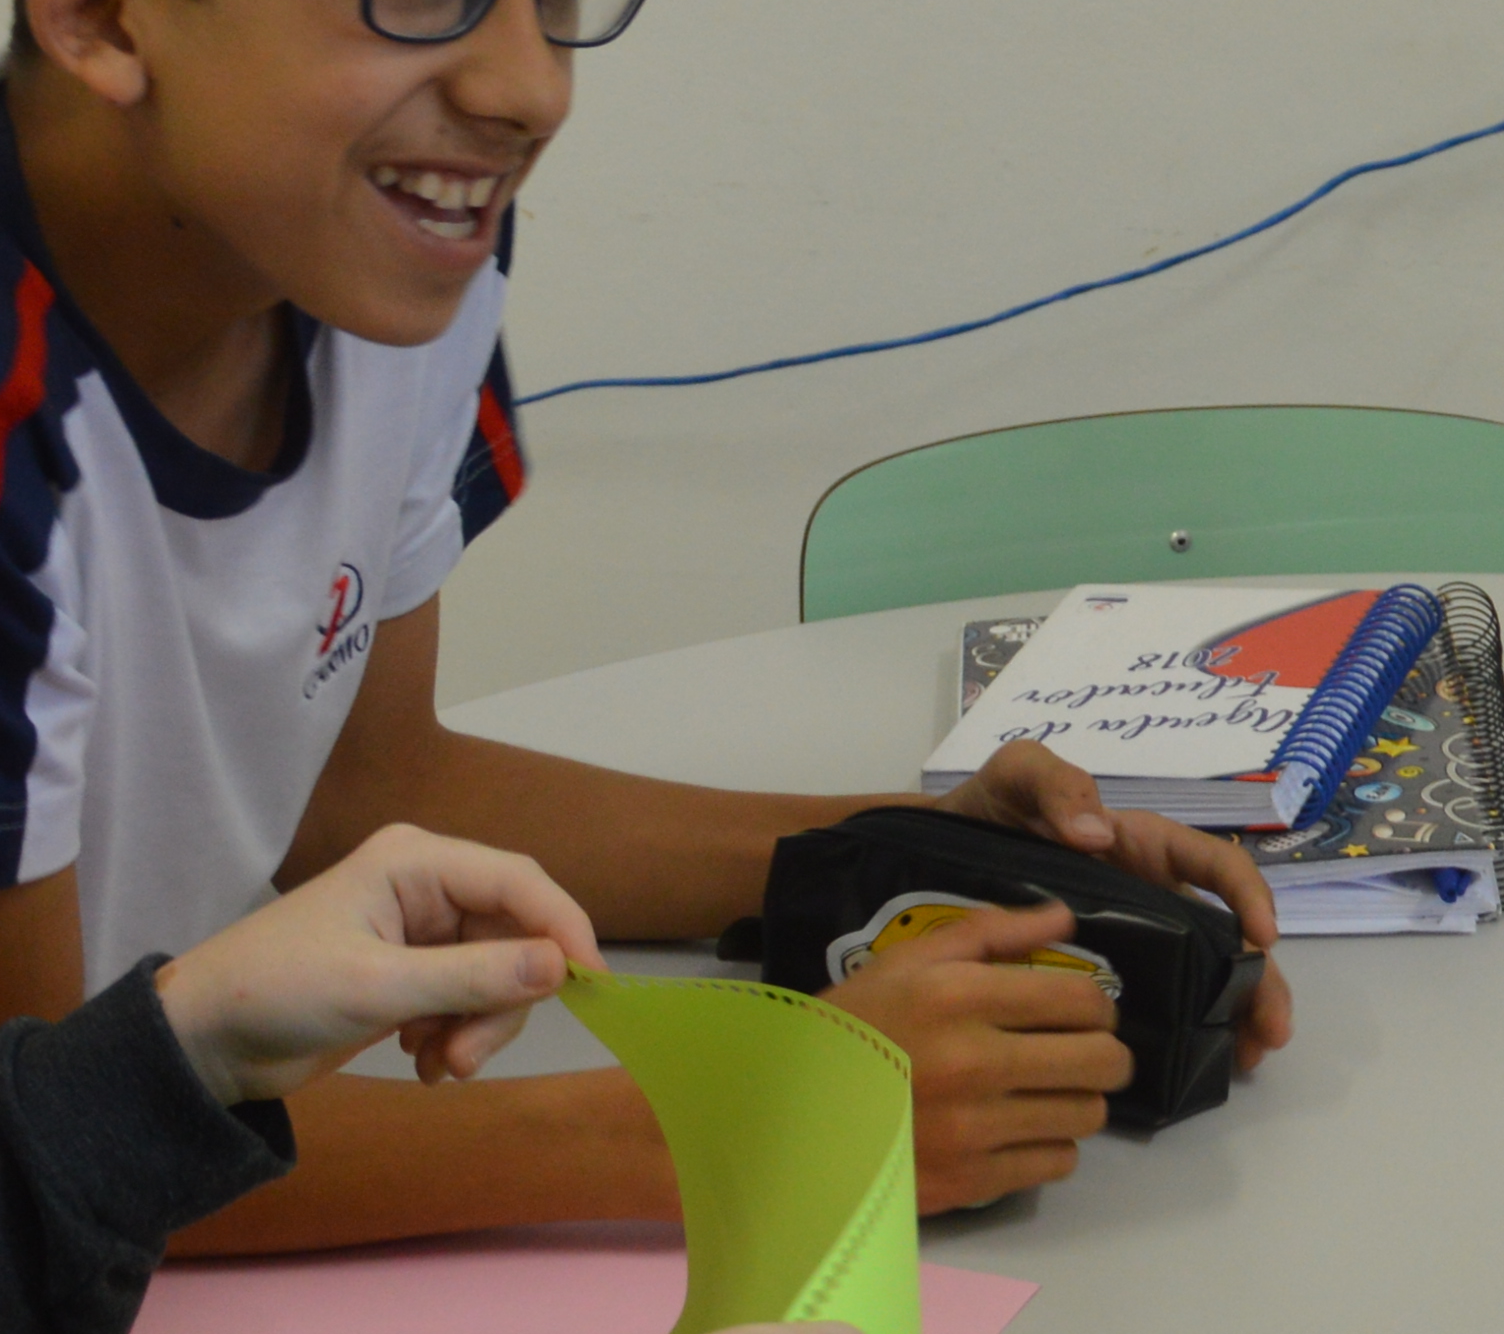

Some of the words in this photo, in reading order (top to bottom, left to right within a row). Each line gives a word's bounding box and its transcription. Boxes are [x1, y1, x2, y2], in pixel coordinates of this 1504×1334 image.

[1128, 645, 1243, 672] 2018
[1012, 670, 1281, 709] Educador
[995, 720, 1073, 743] do
[1087, 698, 1296, 740] Agenda
